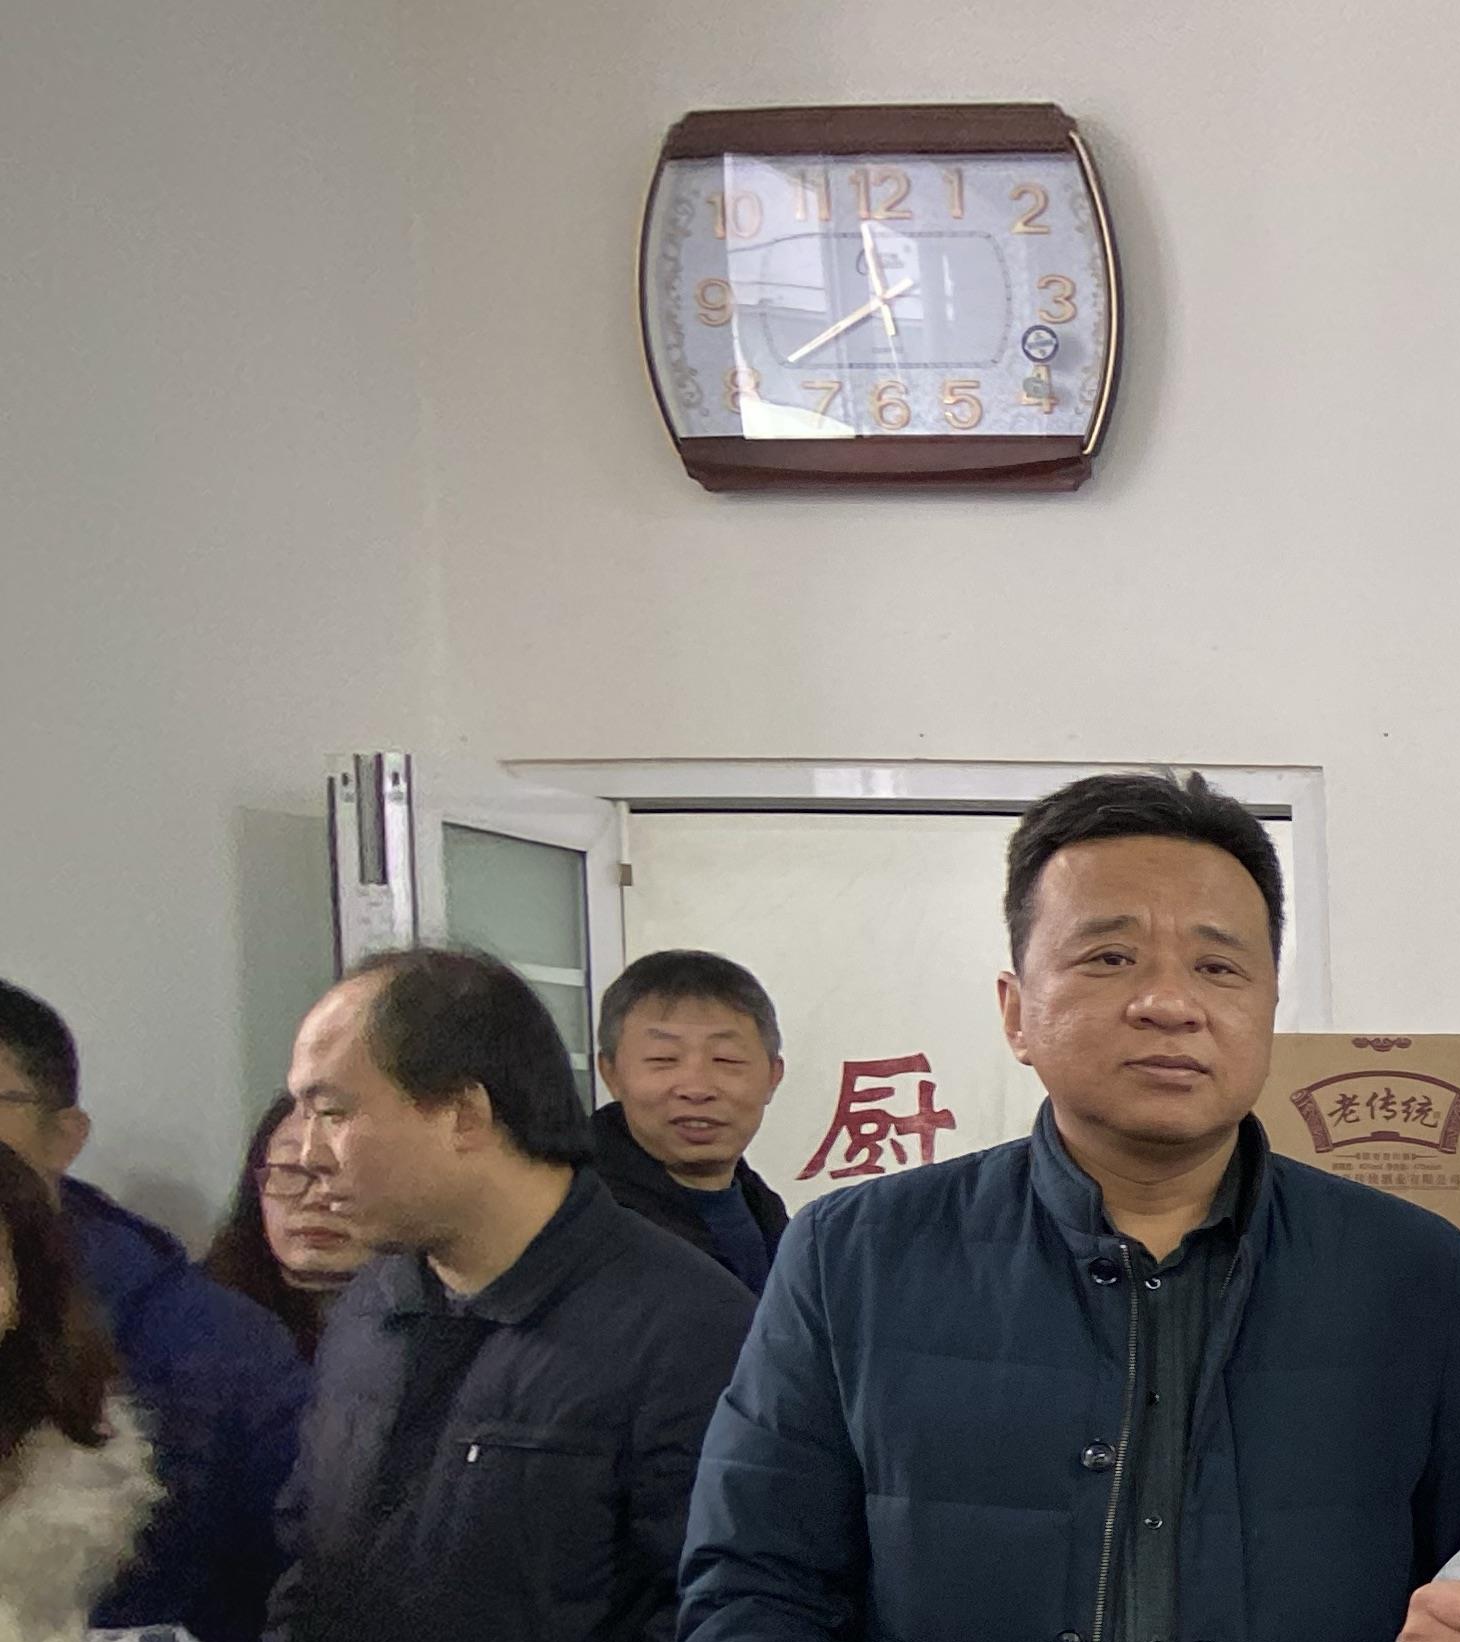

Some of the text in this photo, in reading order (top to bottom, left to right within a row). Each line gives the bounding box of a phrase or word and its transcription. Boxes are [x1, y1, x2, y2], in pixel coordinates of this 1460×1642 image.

[707, 190, 762, 240] 10
[795, 167, 831, 221] 11
[850, 168, 913, 221] 12
[942, 167, 964, 219] 1
[1010, 184, 1051, 235] 2
[696, 279, 732, 327] 9
[1037, 274, 1077, 325] 3
[723, 366, 762, 414] 8
[801, 379, 842, 429] 7
[873, 379, 912, 430] 6
[943, 379, 981, 429] 5
[795, 1052, 957, 1180] 厨
[1327, 1087, 1439, 1129] 老传统
